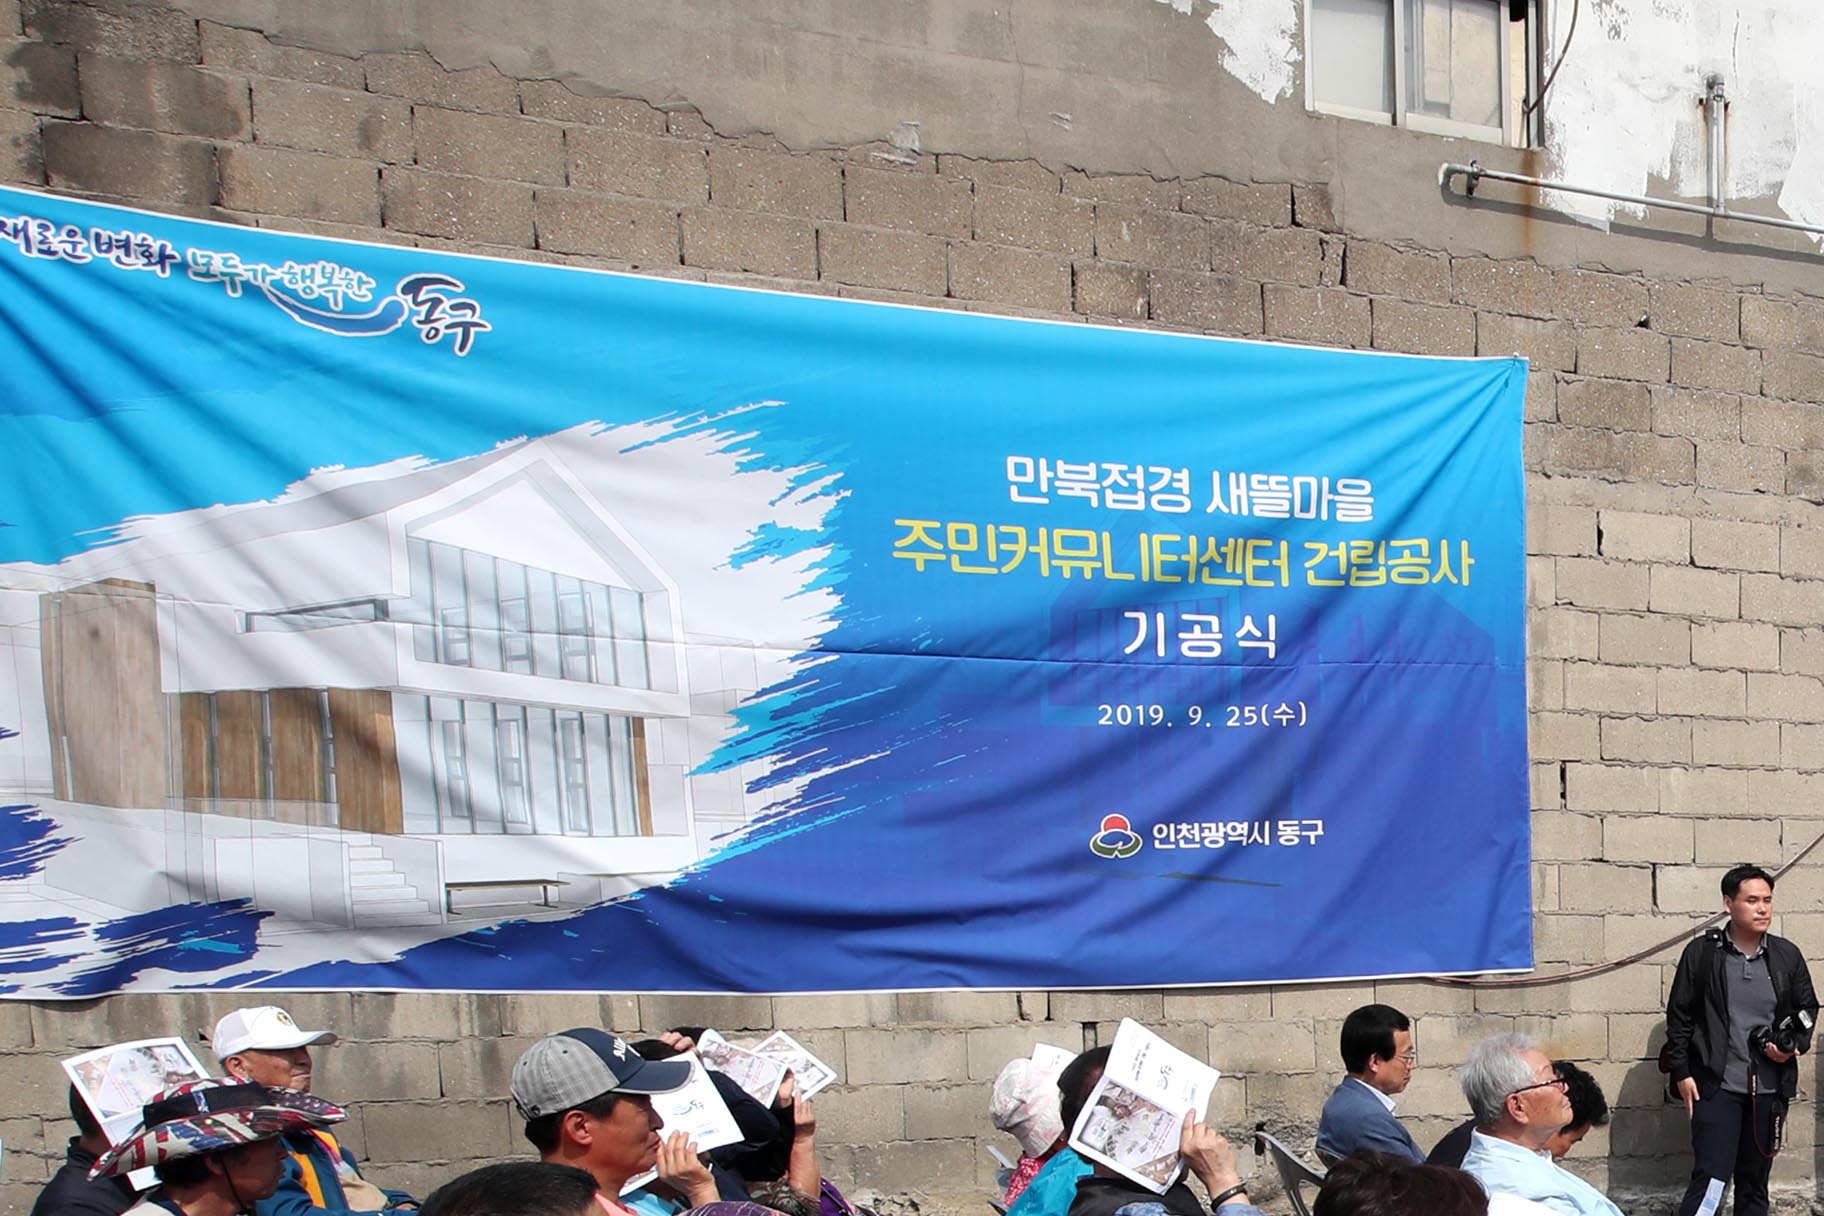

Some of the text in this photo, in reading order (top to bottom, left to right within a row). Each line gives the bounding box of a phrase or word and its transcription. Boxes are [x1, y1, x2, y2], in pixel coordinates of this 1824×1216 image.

[94, 230, 181, 275] 변화
[283, 261, 375, 308] 행복한
[401, 275, 490, 353] 동구
[1006, 455, 1375, 522] 만북접경 새뜰마을
[1303, 538, 1475, 586] 건립공사
[1098, 701, 1308, 728] 2019. 9. 25(수)
[1152, 819, 1325, 850] 인천광역시 동구
